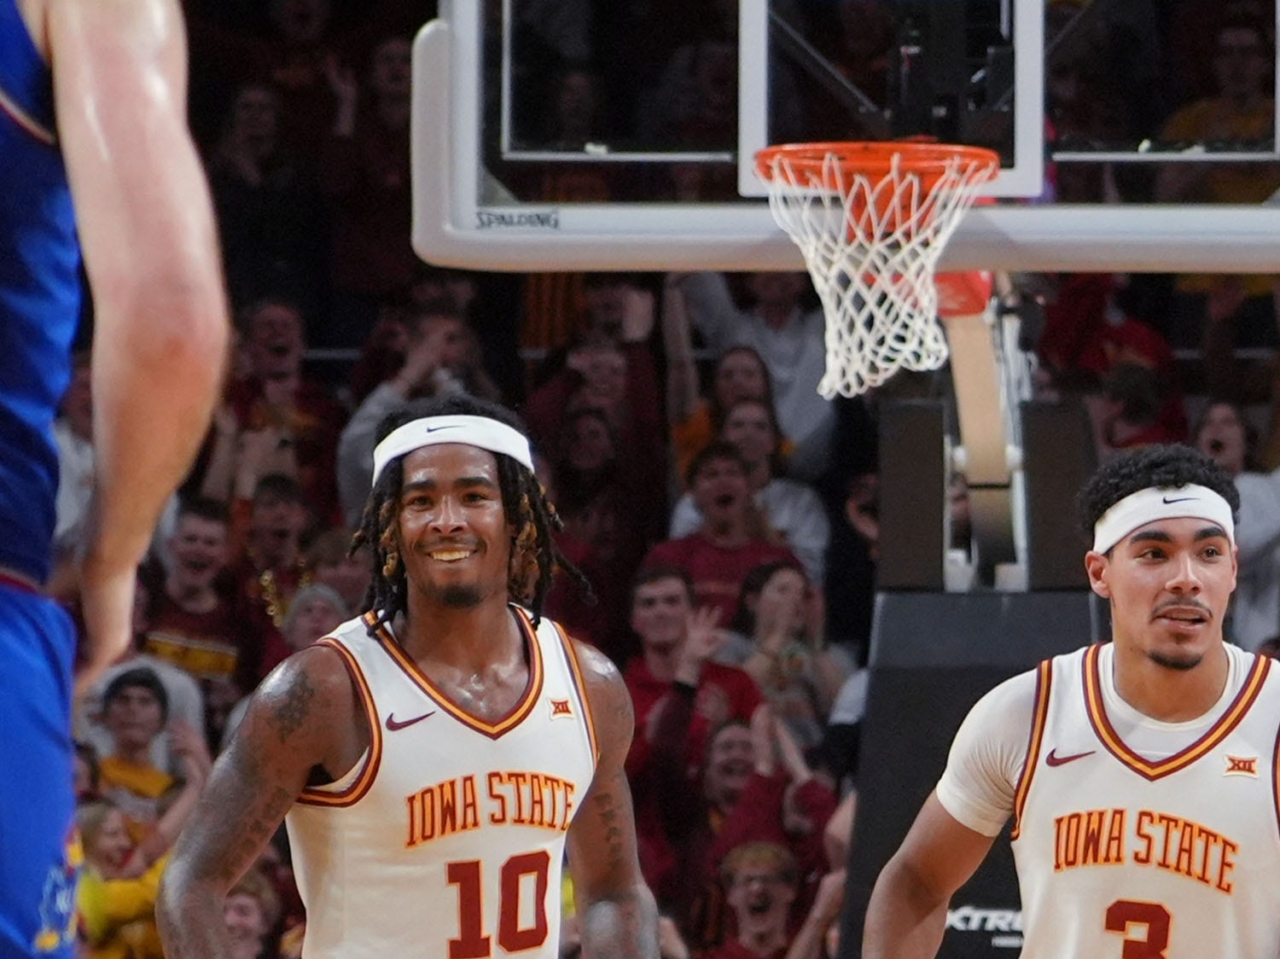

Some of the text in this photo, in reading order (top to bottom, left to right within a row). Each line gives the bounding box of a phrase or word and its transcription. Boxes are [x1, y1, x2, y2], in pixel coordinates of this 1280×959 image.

[476, 211, 559, 229] SPALDING
[406, 770, 578, 849] IOWA STATE
[1053, 808, 1240, 896] IOWA STATE
